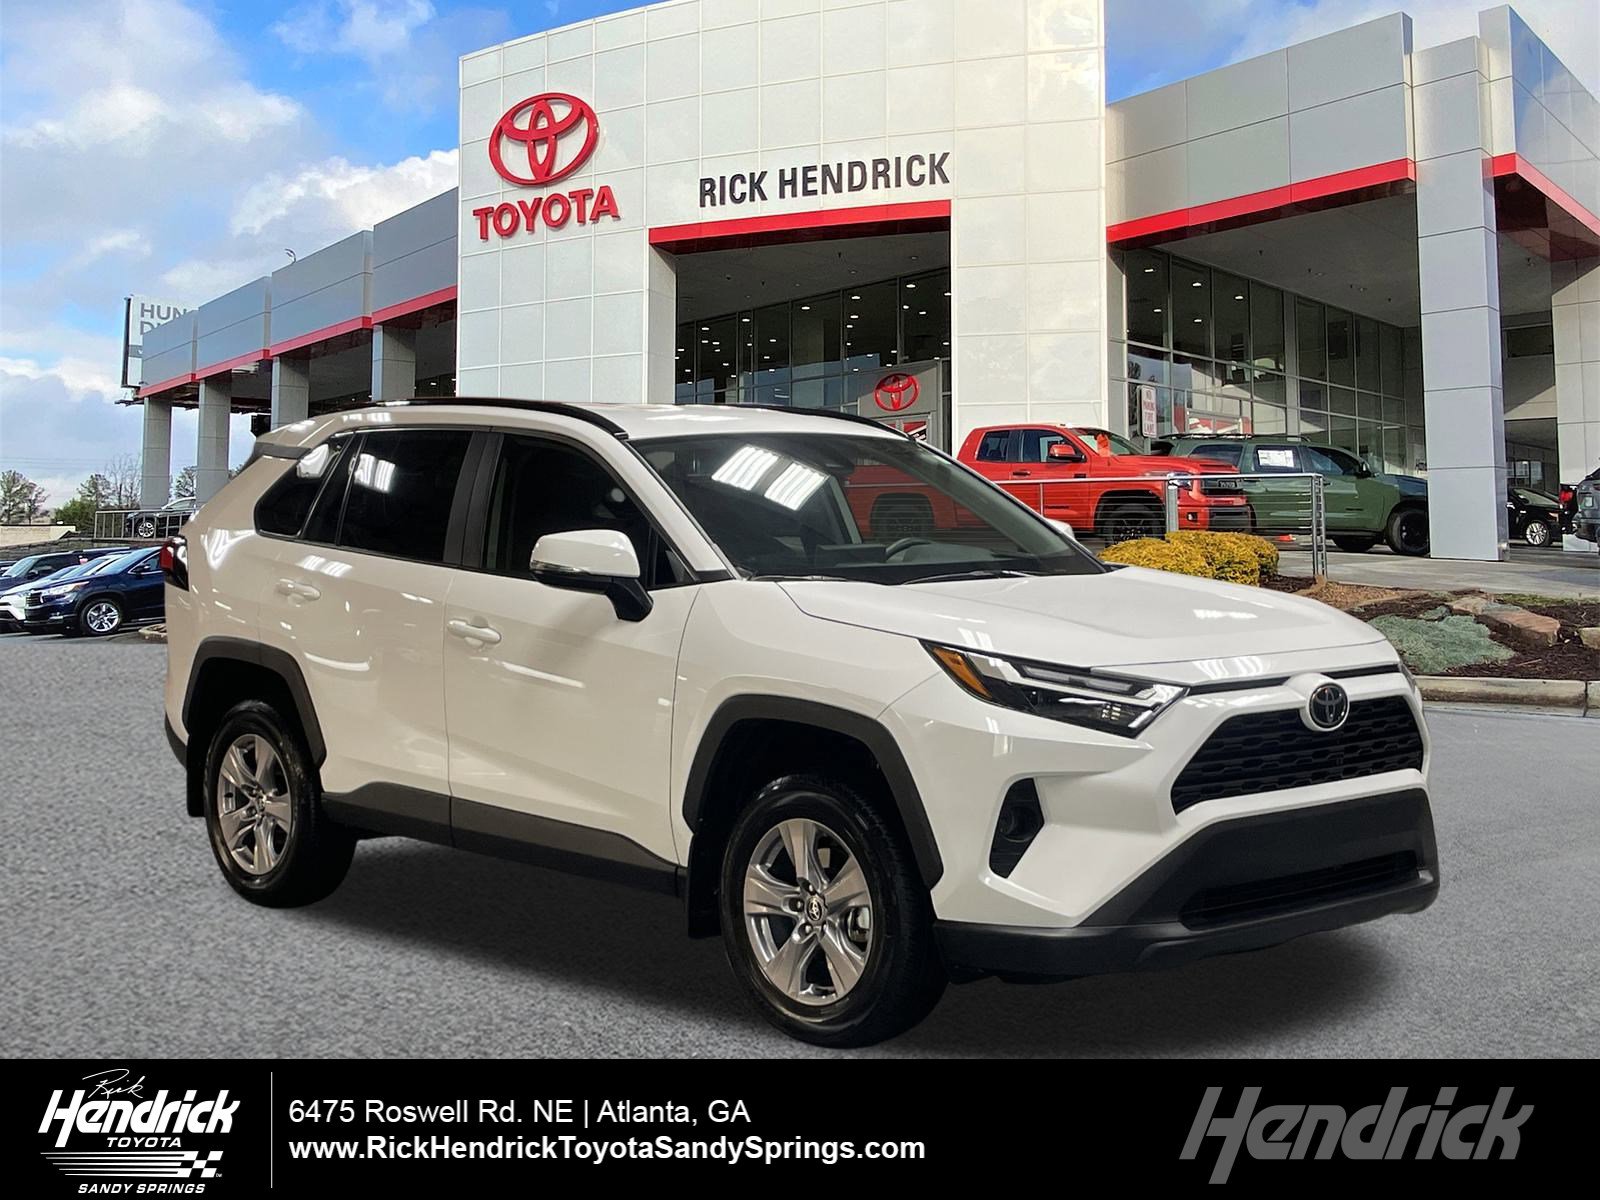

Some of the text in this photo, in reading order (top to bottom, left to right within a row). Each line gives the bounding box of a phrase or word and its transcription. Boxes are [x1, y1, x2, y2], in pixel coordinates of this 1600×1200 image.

[699, 151, 951, 208] RICK HENDRICK
[472, 185, 620, 241] TOYOTA
